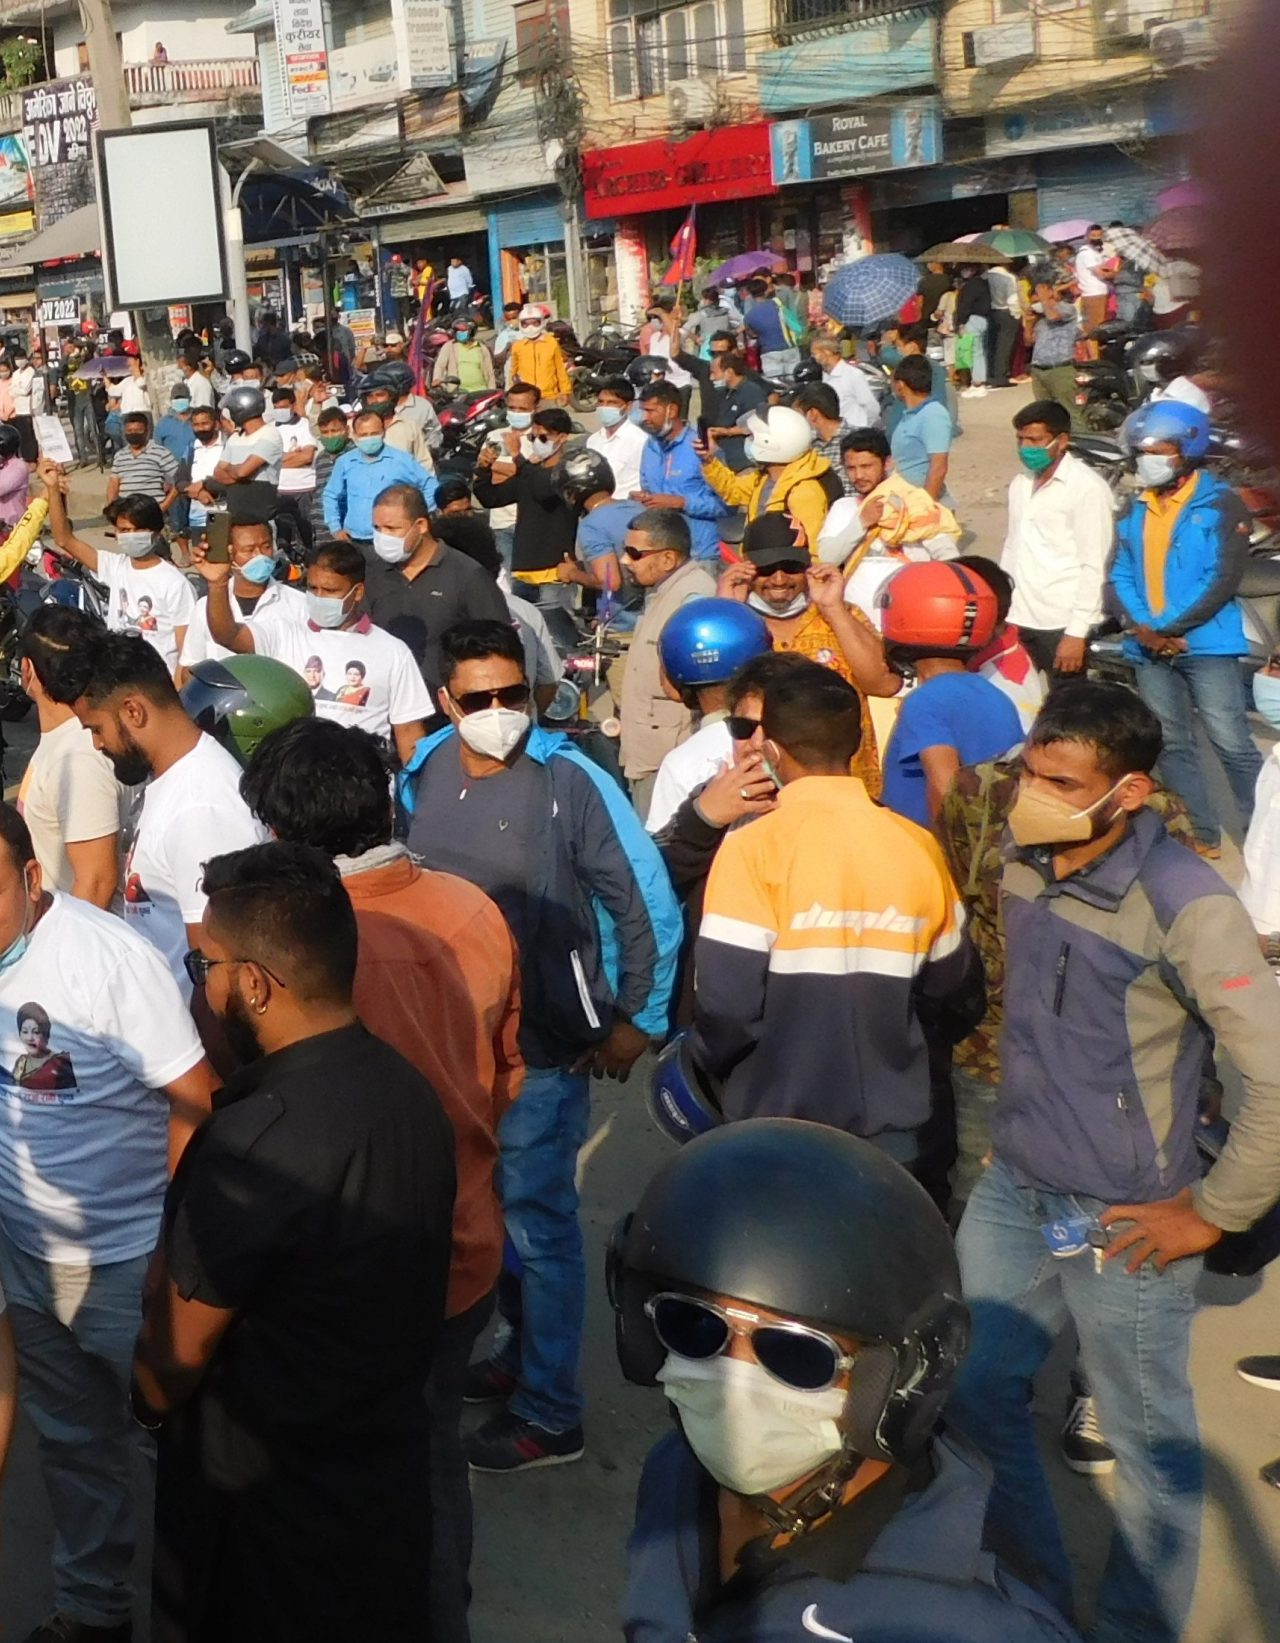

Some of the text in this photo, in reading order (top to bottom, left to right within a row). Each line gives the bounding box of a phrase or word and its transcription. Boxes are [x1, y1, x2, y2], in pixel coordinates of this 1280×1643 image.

[408, 6, 440, 18] Money
[406, 21, 444, 33] Transfer
[291, 83, 321, 95] FedEx
[831, 115, 868, 132] ROYAL
[813, 138, 856, 156] BAKERY
[857, 133, 889, 149] CAFE
[55, 299, 75, 320] 2022
